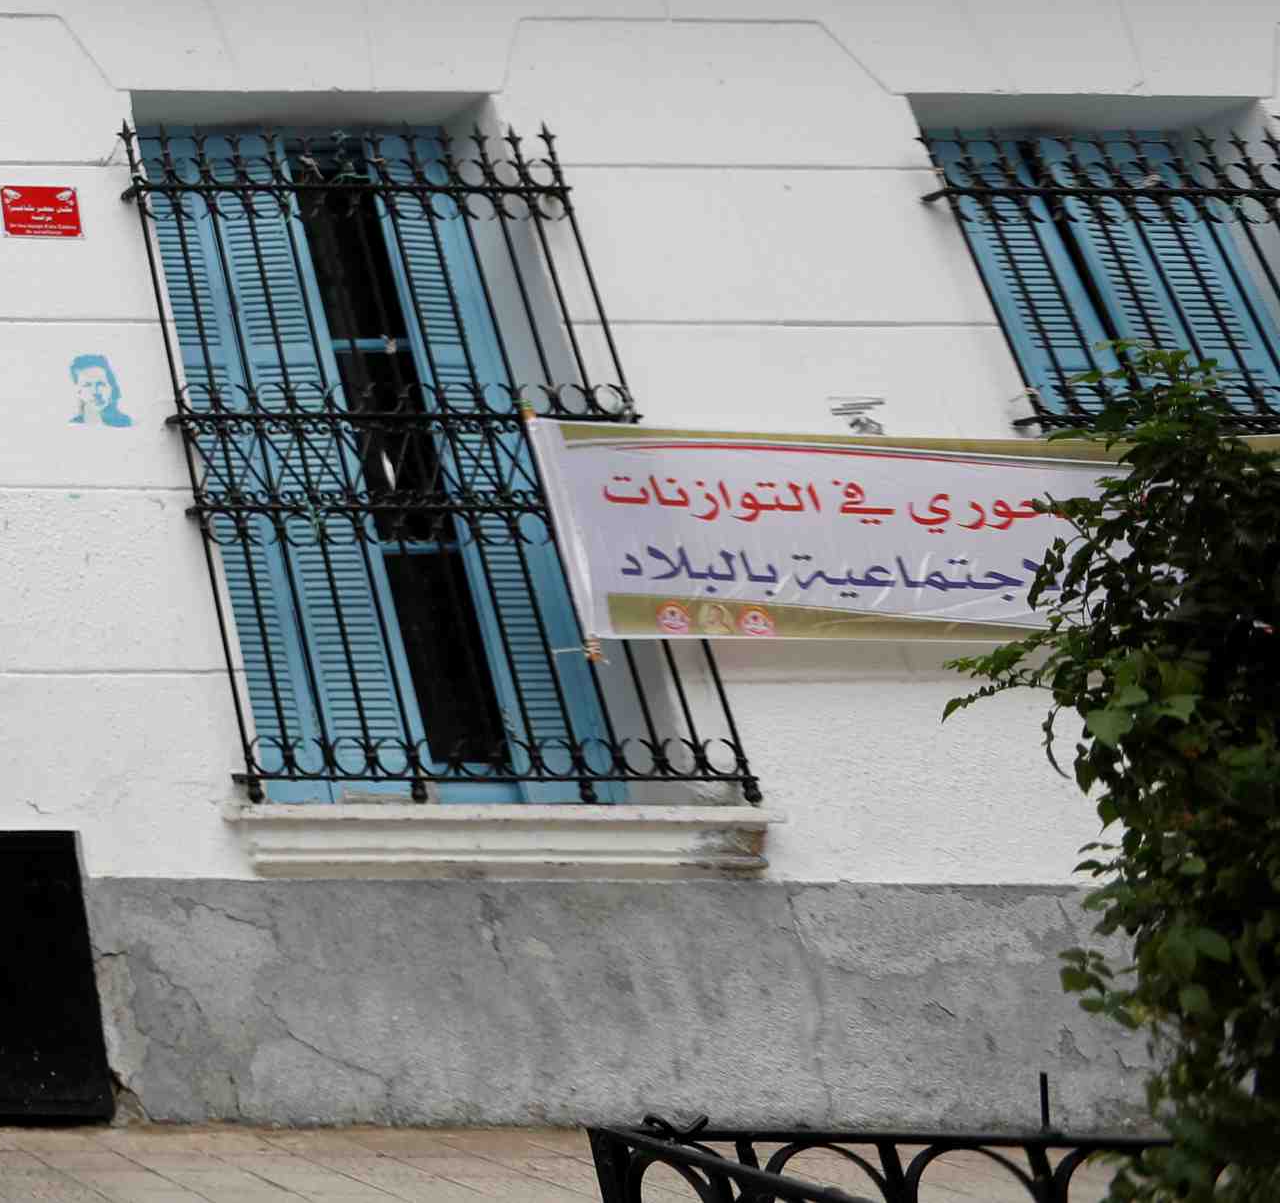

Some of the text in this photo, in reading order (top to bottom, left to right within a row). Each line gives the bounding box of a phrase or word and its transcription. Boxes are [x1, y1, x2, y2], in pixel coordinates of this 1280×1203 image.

[601, 474, 822, 522] التوازنات
[831, 479, 898, 526] في
[620, 544, 778, 597] بالبلاد
